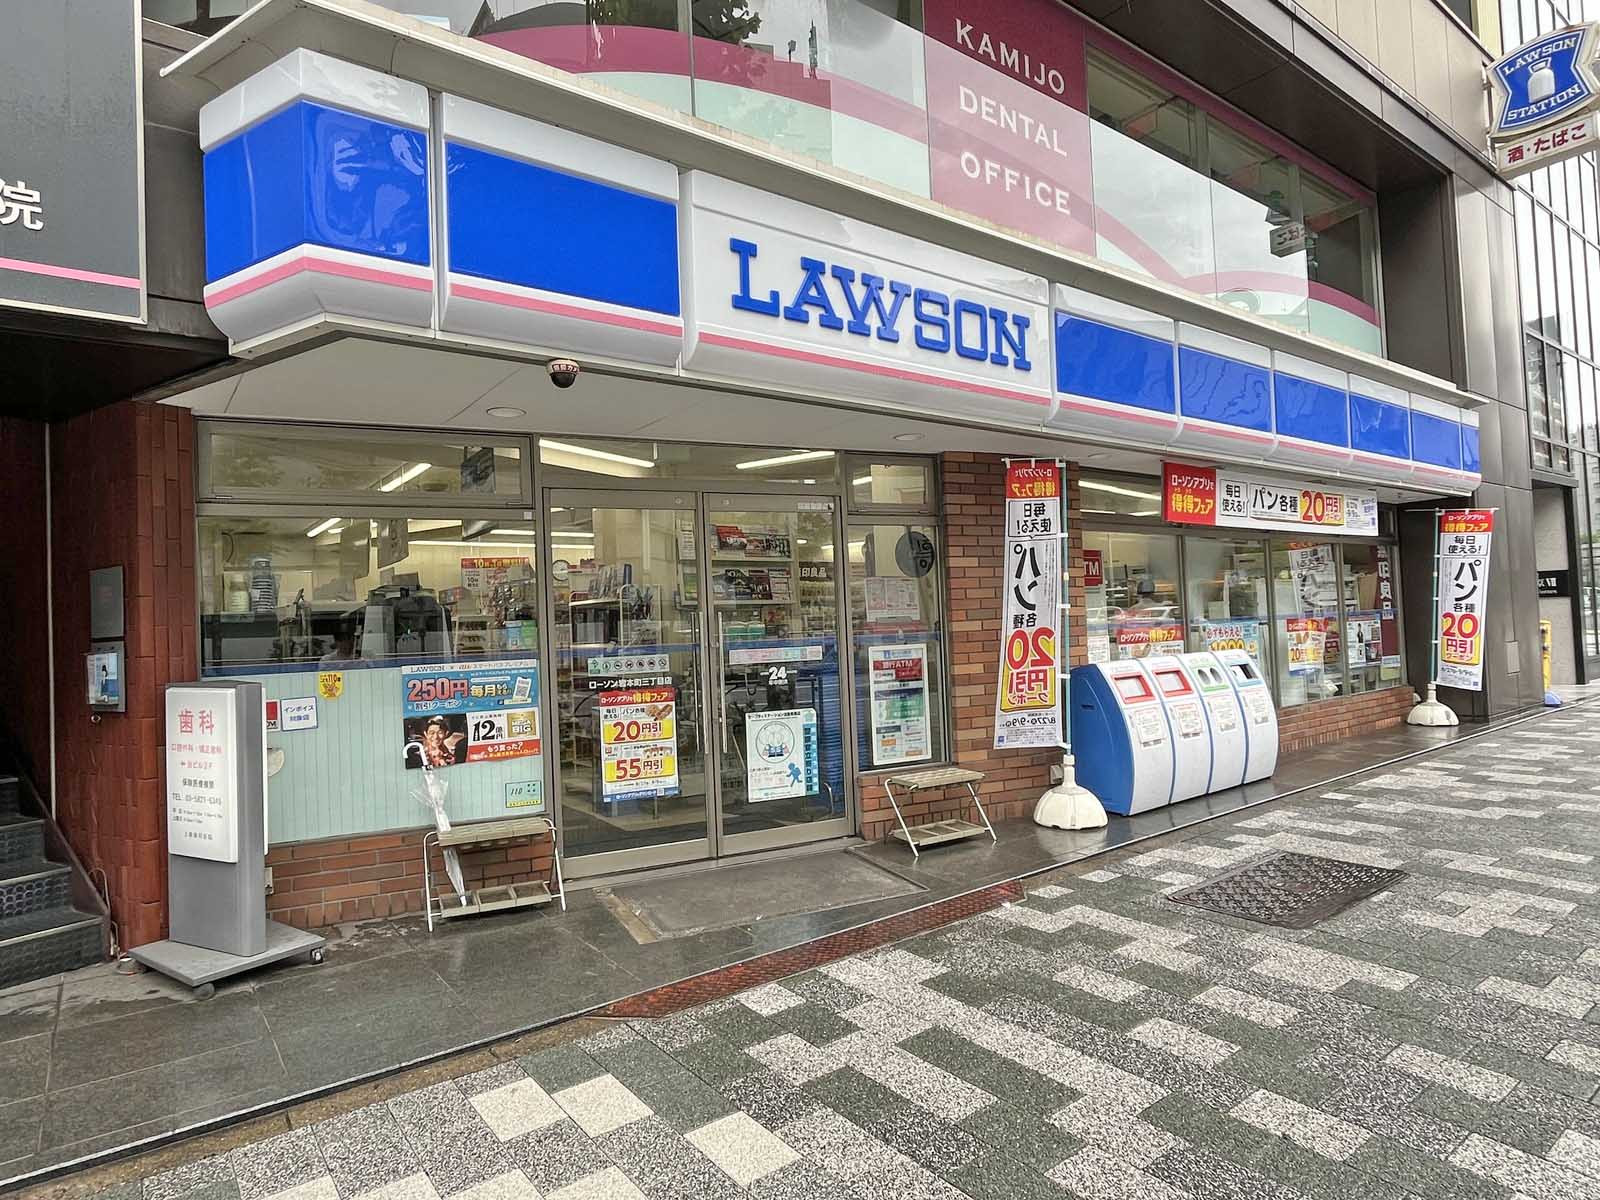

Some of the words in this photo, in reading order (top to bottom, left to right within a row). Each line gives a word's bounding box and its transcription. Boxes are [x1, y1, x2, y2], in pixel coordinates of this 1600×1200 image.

[955, 18, 1065, 95] KAMIJO
[1503, 37, 1577, 76] LAWSON
[1507, 83, 1581, 121] STATION
[959, 85, 1067, 156] DENTAL
[1507, 124, 1587, 163] 酒・たばこ
[960, 151, 1070, 215] OFFICE
[729, 237, 1031, 371] LAWSON
[1171, 475, 1214, 491] ローソンアプリで
[1225, 484, 1241, 498] 毎日
[1172, 493, 1214, 514] 得得フェア
[1222, 498, 1246, 514] 使える!
[1252, 487, 1298, 512] パン各種
[1444, 522, 1489, 532] 得得フェア
[1448, 545, 1482, 554] 使える!
[1454, 535, 1476, 545] 毎日
[1453, 559, 1482, 602] パン
[1453, 603, 1475, 613] 各種
[1442, 612, 1478, 639] 20
[1446, 639, 1473, 654] 円引
[407, 677, 468, 702] 250円
[470, 682, 496, 698] 毎月
[178, 708, 214, 735] 歯科
[472, 719, 496, 742] 12
